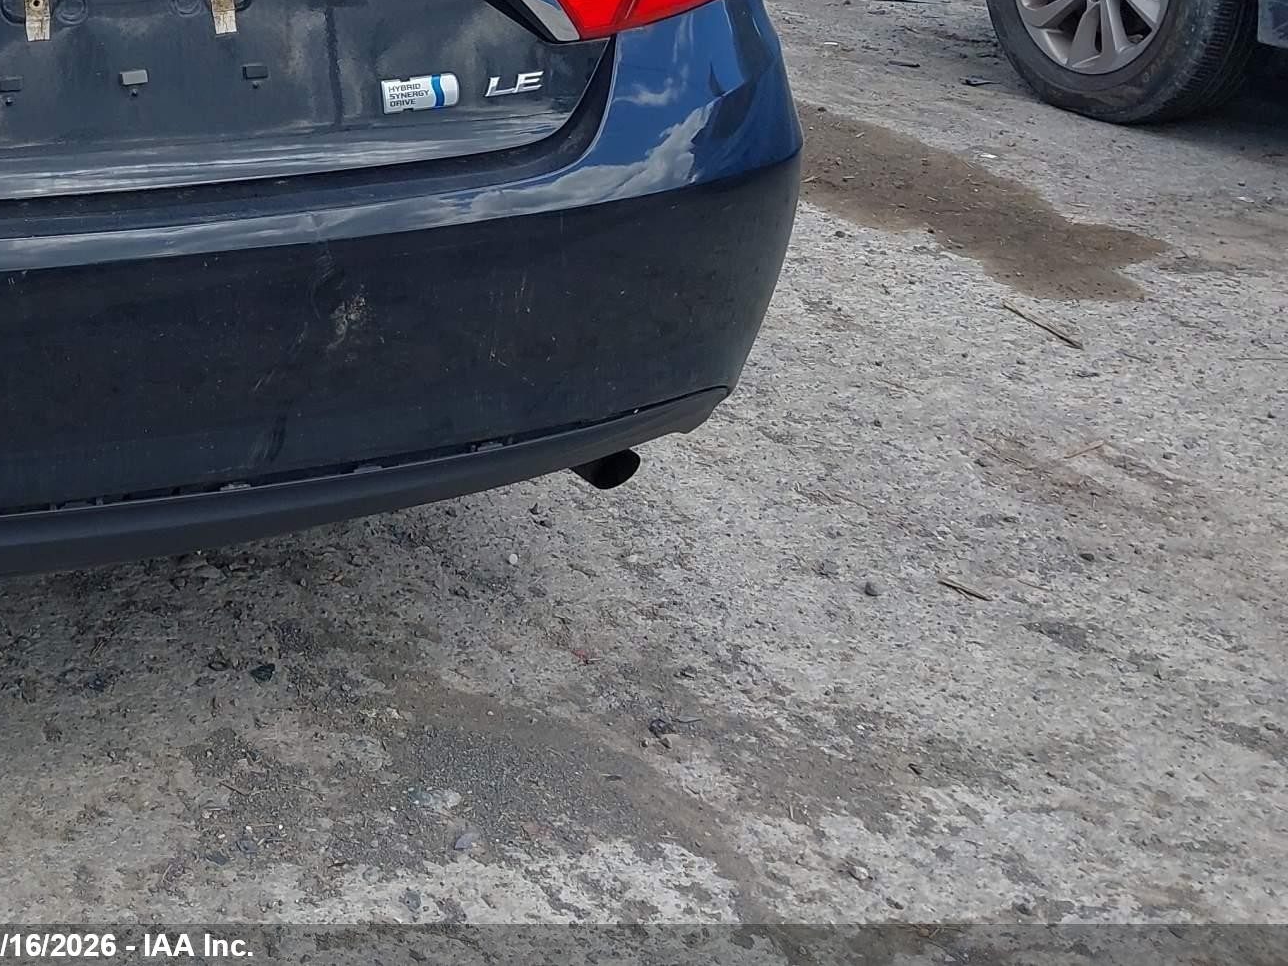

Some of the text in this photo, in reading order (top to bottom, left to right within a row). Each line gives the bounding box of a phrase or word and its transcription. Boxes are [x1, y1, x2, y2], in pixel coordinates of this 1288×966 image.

[388, 83, 421, 93] HYBRID
[485, 70, 544, 97] LE
[389, 90, 430, 100] SYNERGY
[389, 98, 417, 108] DRIVE
